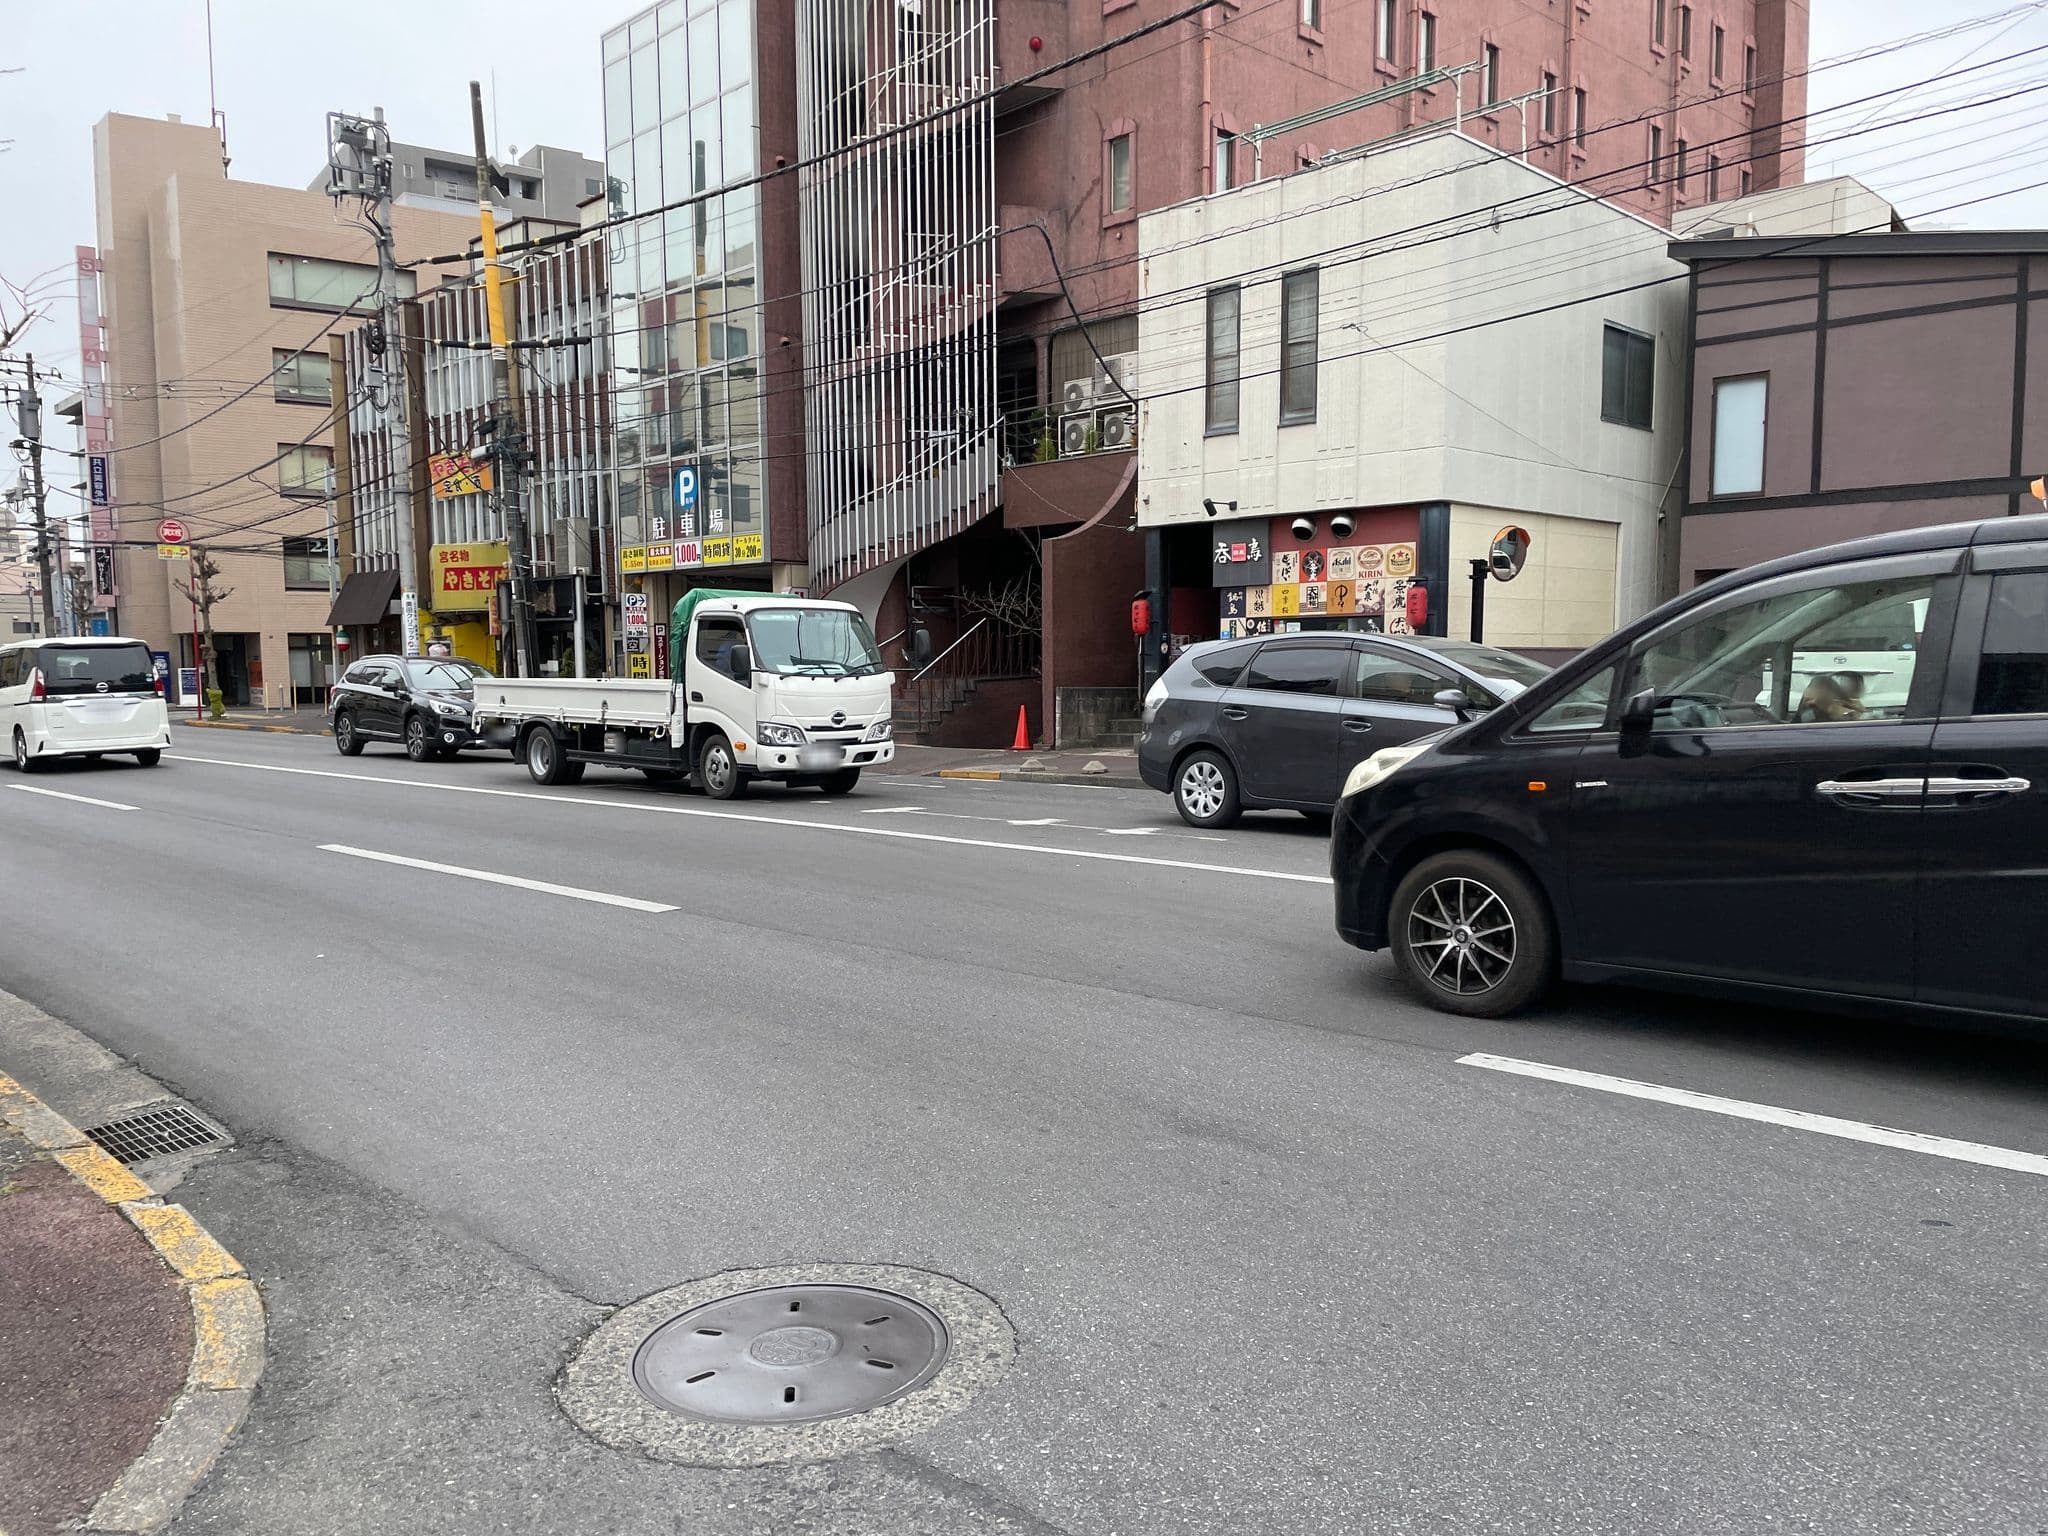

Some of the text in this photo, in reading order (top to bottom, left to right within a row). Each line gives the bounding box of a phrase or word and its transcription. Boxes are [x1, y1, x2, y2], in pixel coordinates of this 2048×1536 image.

[82, 259, 93, 271] 5
[85, 352, 96, 363] 4
[679, 469, 694, 506] P
[652, 508, 724, 540] 駐車場
[439, 550, 470, 563] 宮名物
[675, 543, 701, 563] 1,000円
[1332, 556, 1352, 567] Asahi
[1358, 570, 1383, 579] KIRIN
